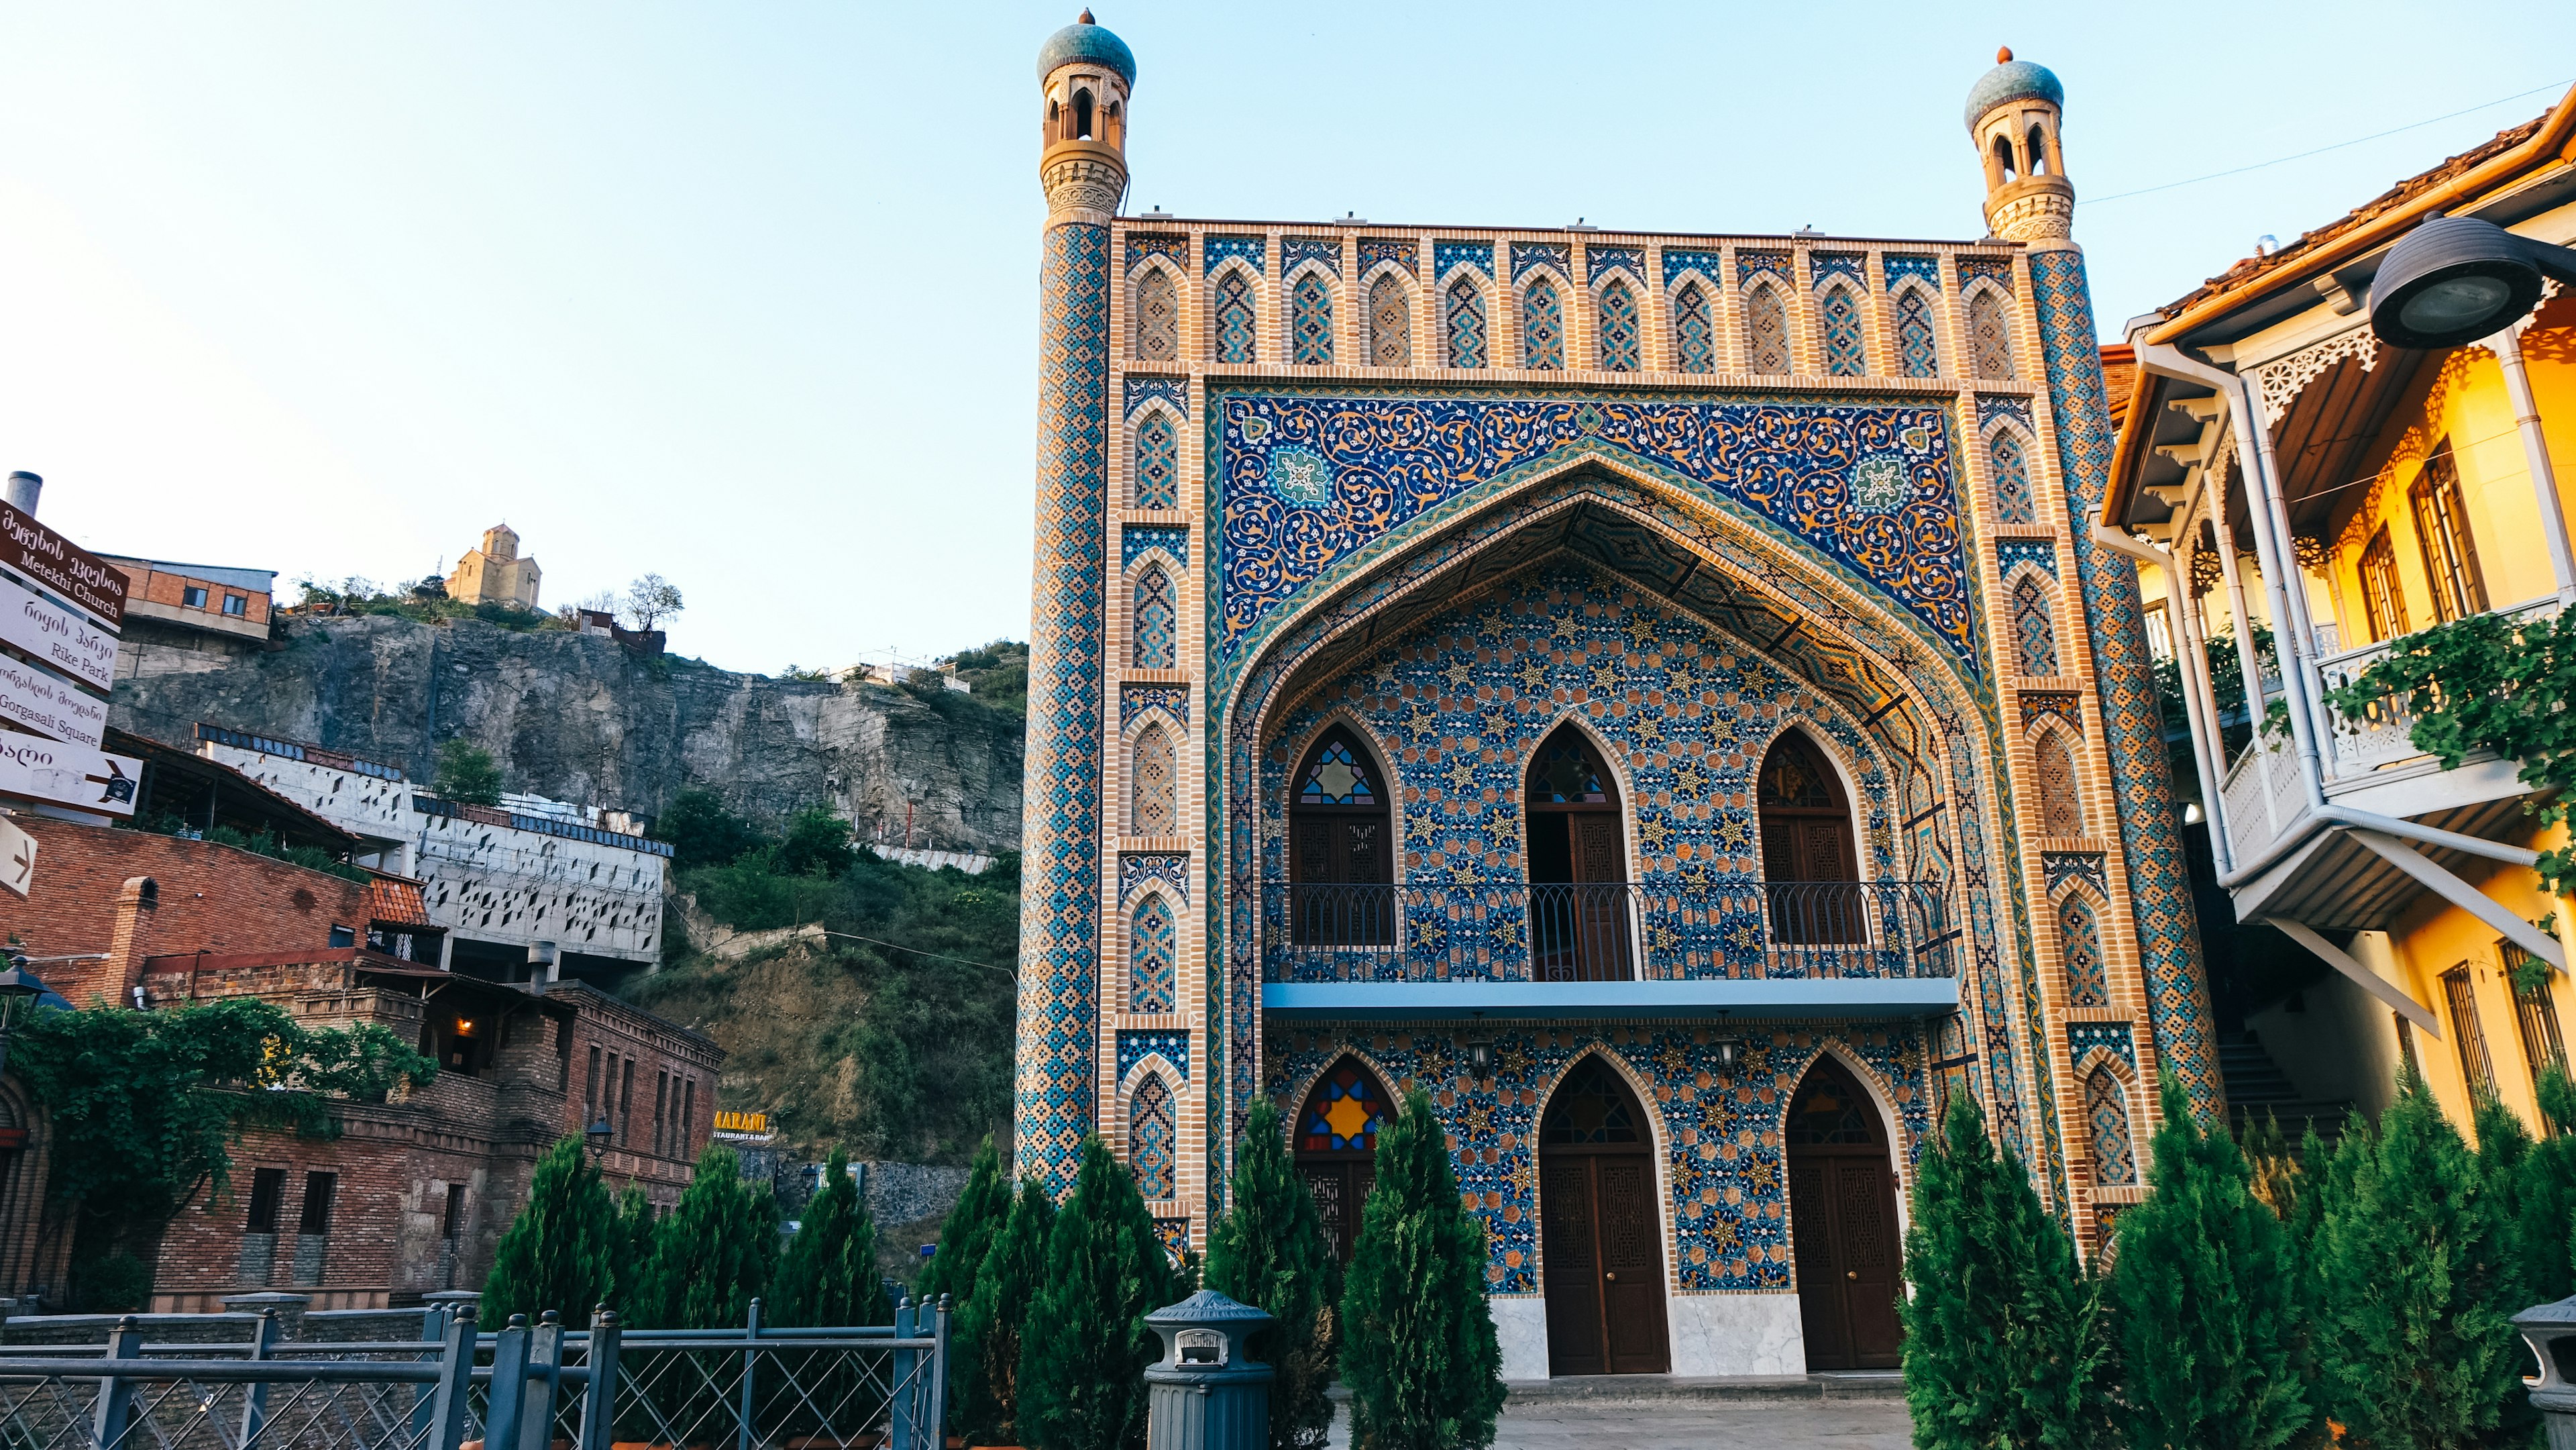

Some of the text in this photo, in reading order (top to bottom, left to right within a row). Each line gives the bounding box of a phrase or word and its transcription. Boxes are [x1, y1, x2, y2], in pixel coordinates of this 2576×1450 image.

[3, 510, 123, 597] მეტეხის ეკლესია
[20, 550, 118, 619] Metekhi Church
[24, 601, 113, 661] რიყის პარკი
[50, 642, 109, 682] Rike Park
[0, 694, 98, 747] Gorgasali Square
[58, 690, 102, 721] მოედანი
[0, 737, 53, 768] ალი
